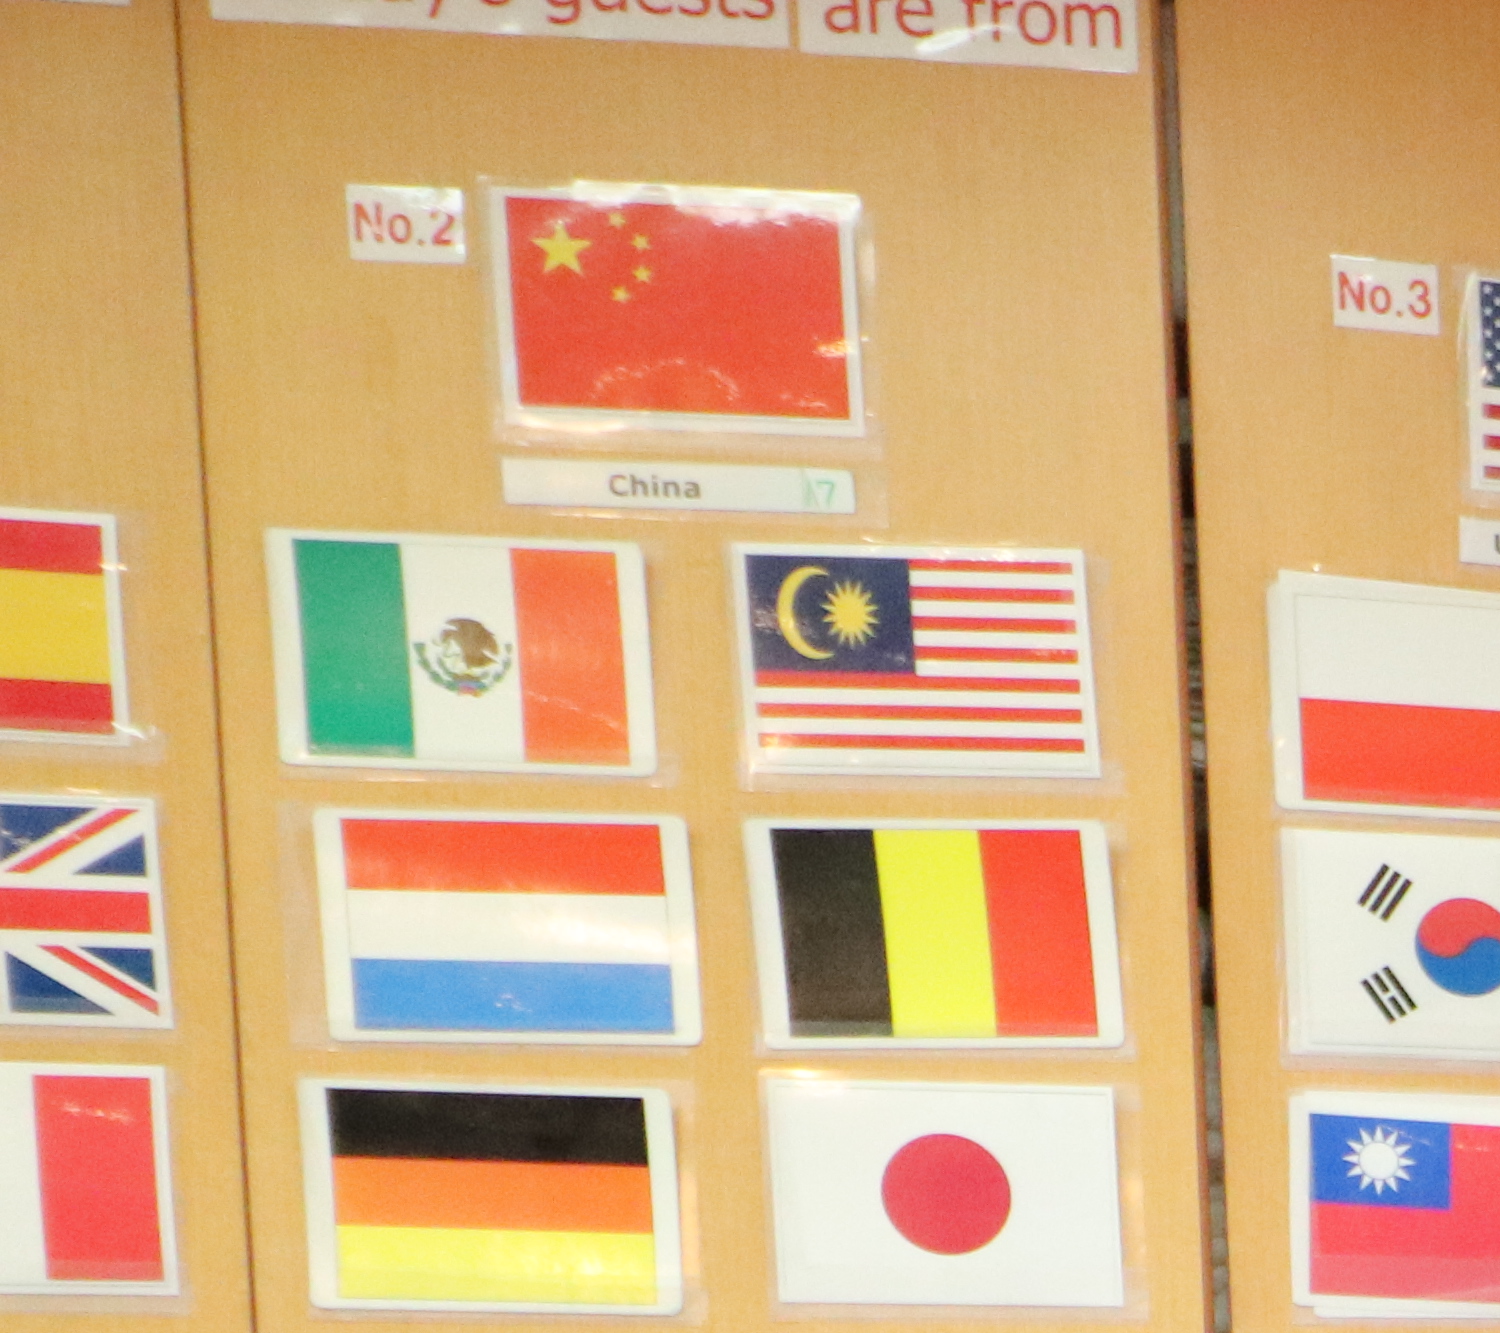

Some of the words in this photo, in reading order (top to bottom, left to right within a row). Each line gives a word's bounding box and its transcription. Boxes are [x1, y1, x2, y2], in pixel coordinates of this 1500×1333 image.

[354, 202, 455, 246] No.2
[1337, 271, 1432, 320] No.3
[609, 473, 701, 499] China
